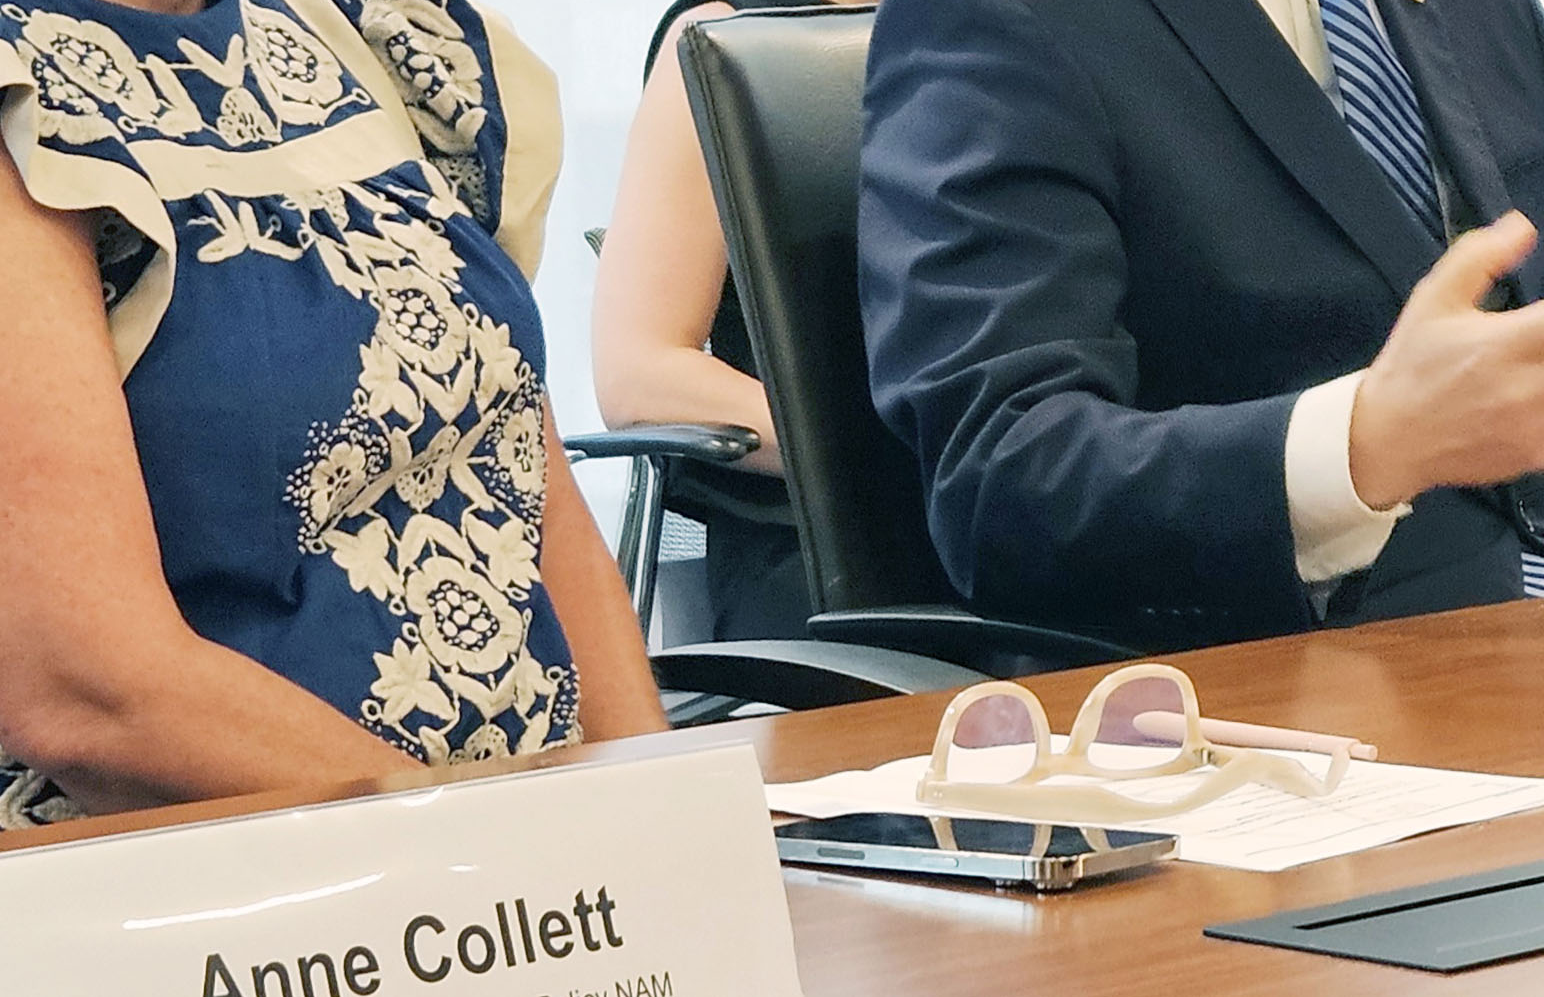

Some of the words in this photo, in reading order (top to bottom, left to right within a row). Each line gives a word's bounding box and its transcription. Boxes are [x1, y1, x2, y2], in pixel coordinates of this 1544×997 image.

[203, 945, 381, 997] Anne
[404, 885, 624, 983] Collett
[615, 971, 673, 997] NAM
